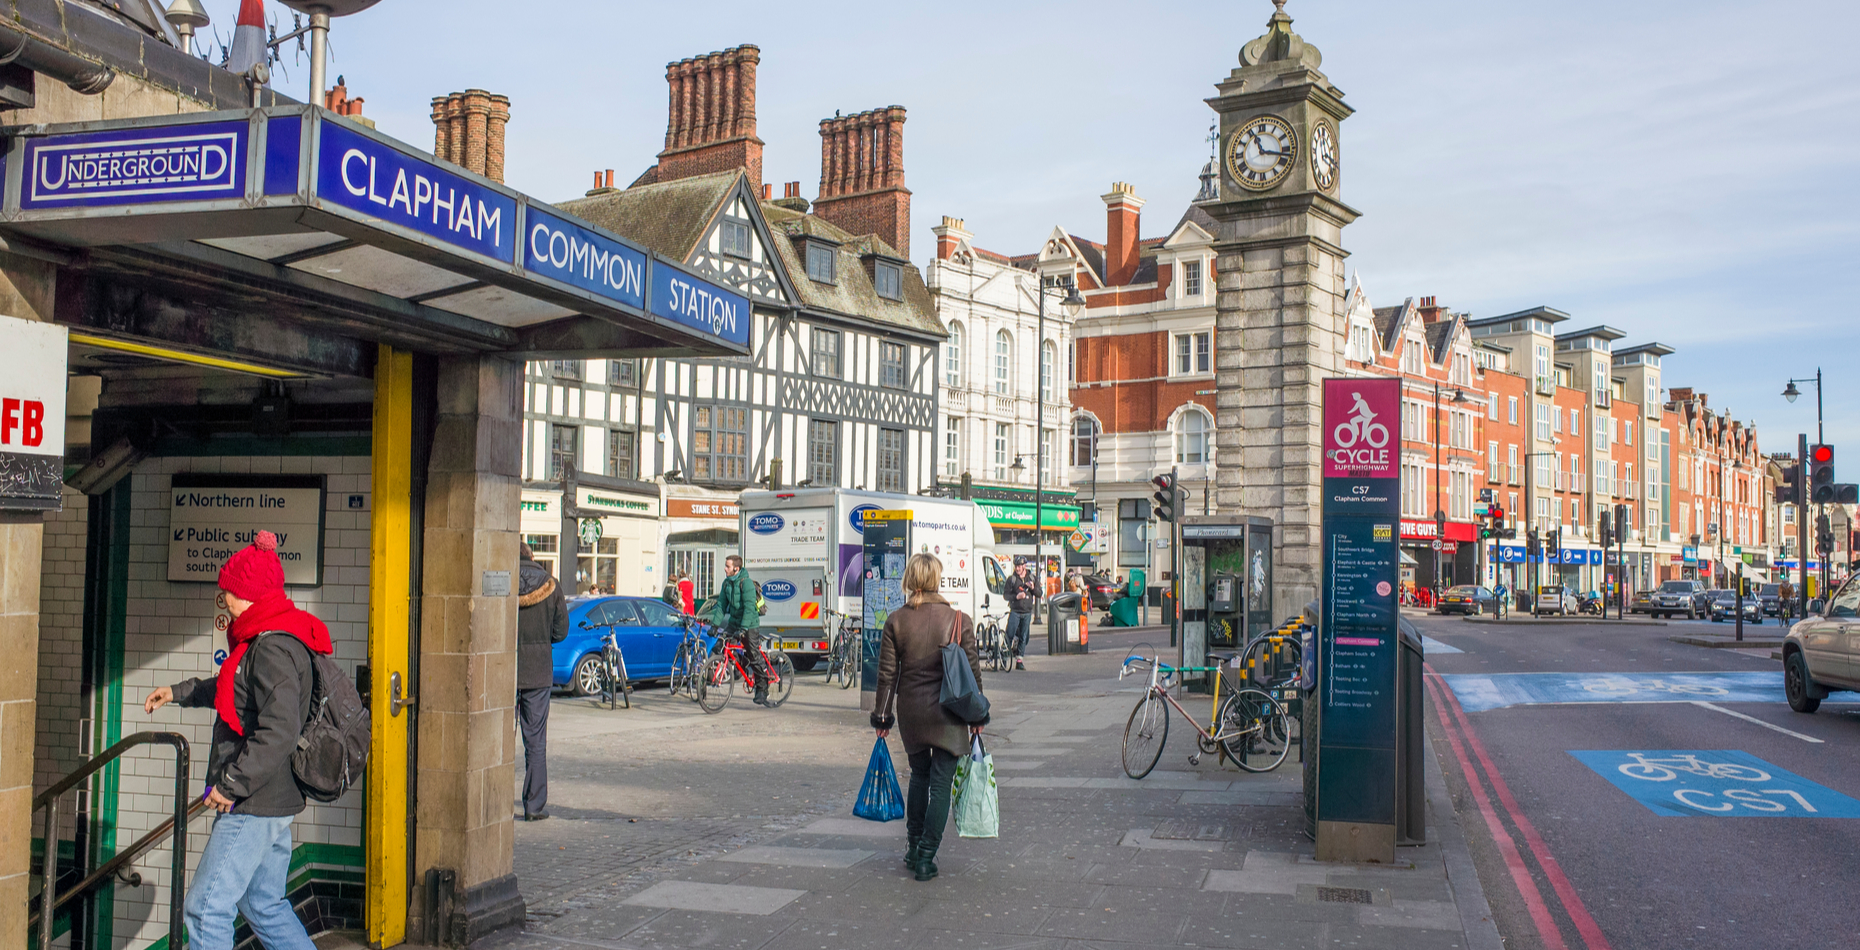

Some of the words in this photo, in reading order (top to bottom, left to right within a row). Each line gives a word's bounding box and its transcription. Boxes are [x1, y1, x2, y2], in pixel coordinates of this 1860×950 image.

[41, 145, 228, 190] UNDERGROUND
[341, 148, 501, 247] CLAPHAM
[531, 223, 641, 297] COMMON
[669, 278, 736, 334] STATION
[1, 398, 44, 447] FB
[1334, 449, 1389, 464] CYCLE
[1352, 485, 1370, 494] CS7
[189, 493, 254, 508] Northern
[260, 494, 286, 508] line
[587, 494, 624, 509] STARBUCKS
[625, 500, 649, 511] COFFEE
[1334, 495, 1360, 503] Clapham
[691, 504, 710, 515] STANE
[711, 505, 721, 515] ST.
[1011, 511, 1033, 521] Clapham
[1400, 522, 1415, 535] FIVE
[1417, 523, 1437, 536] GUYS
[187, 528, 229, 542] Public
[234, 529, 288, 546] suby
[187, 549, 198, 558] to
[202, 547, 239, 560] Claph
[278, 551, 302, 560] mon
[186, 562, 216, 572] south
[948, 577, 968, 588] TEAM
[1673, 788, 1818, 813] CS7
